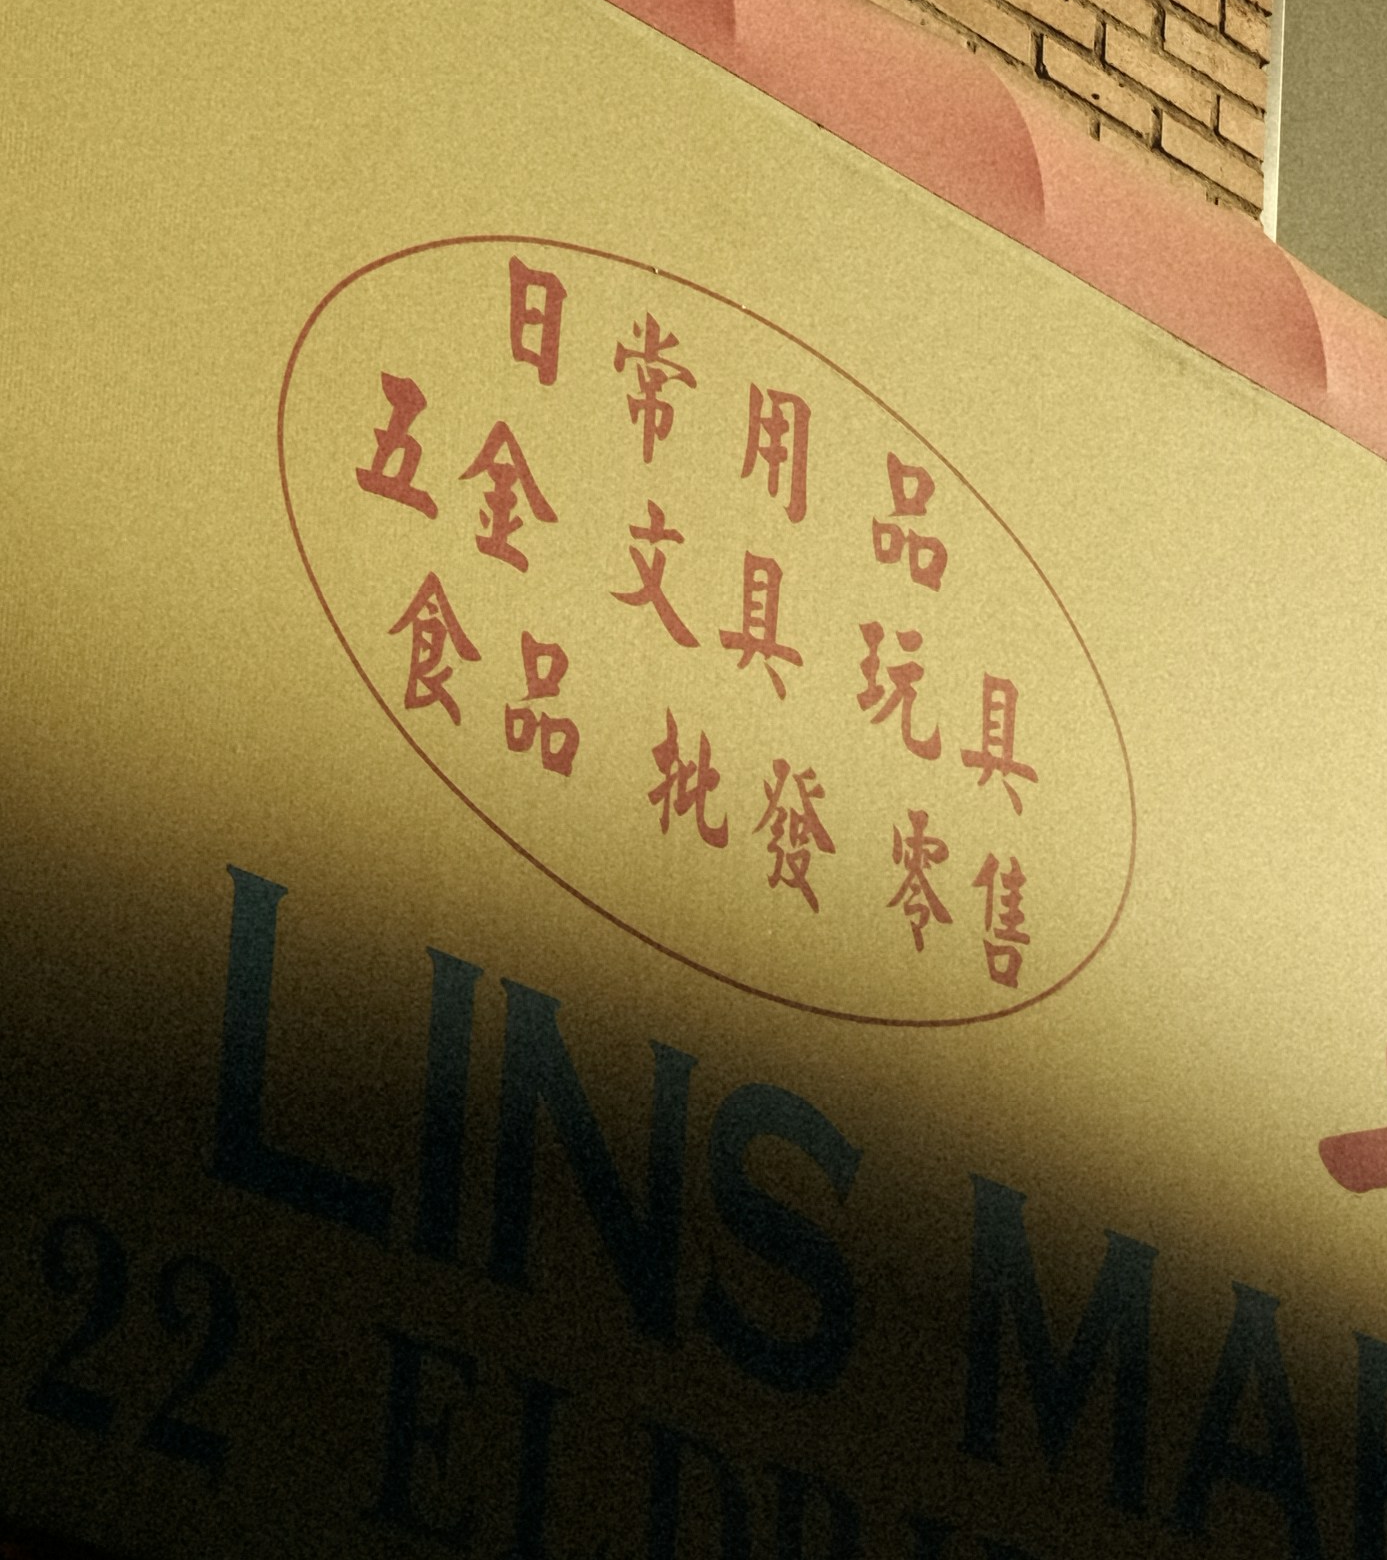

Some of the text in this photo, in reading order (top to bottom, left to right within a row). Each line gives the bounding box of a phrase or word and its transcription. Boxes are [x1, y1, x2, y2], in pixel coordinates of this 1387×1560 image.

[354, 371, 1039, 816] 五金 文具 玩具
[507, 256, 950, 591] 日常用品
[387, 571, 1031, 990] 食品 批發 零售
[206, 863, 862, 1395] LINS
[23, 1211, 244, 1478] 22
